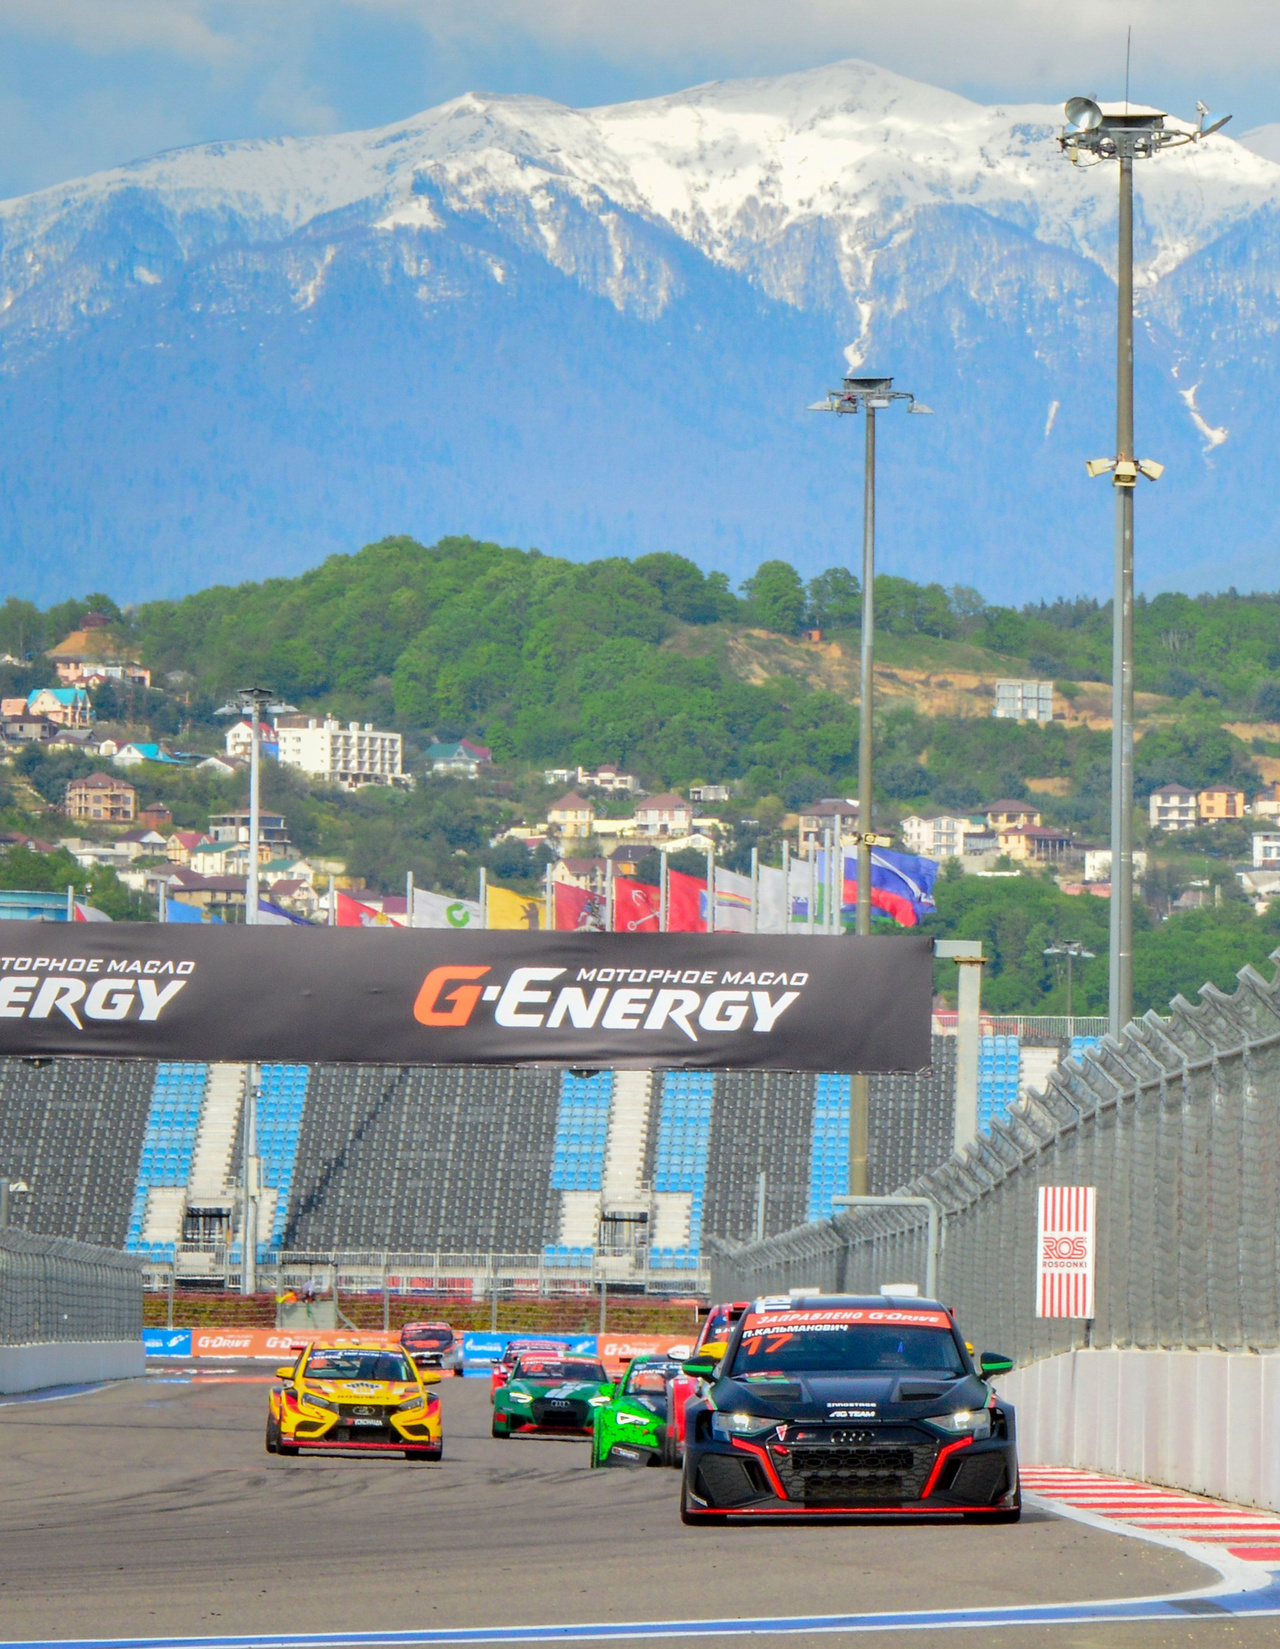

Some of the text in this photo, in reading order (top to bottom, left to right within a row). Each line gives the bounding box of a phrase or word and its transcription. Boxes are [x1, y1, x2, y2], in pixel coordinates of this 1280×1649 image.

[106, 959, 196, 975] МАСЛО
[576, 967, 810, 987] МОТОРНОЕ МАСЛО
[1043, 1236, 1088, 1260] ROS
[1042, 1260, 1088, 1269] ROSGONKI
[756, 1311, 864, 1325] ЗАПРАВЛЕНО
[741, 1324, 850, 1339] П.КАЛЬМАНОВИЧ
[741, 1333, 794, 1356] 17
[848, 1410, 876, 1418] TEAM
